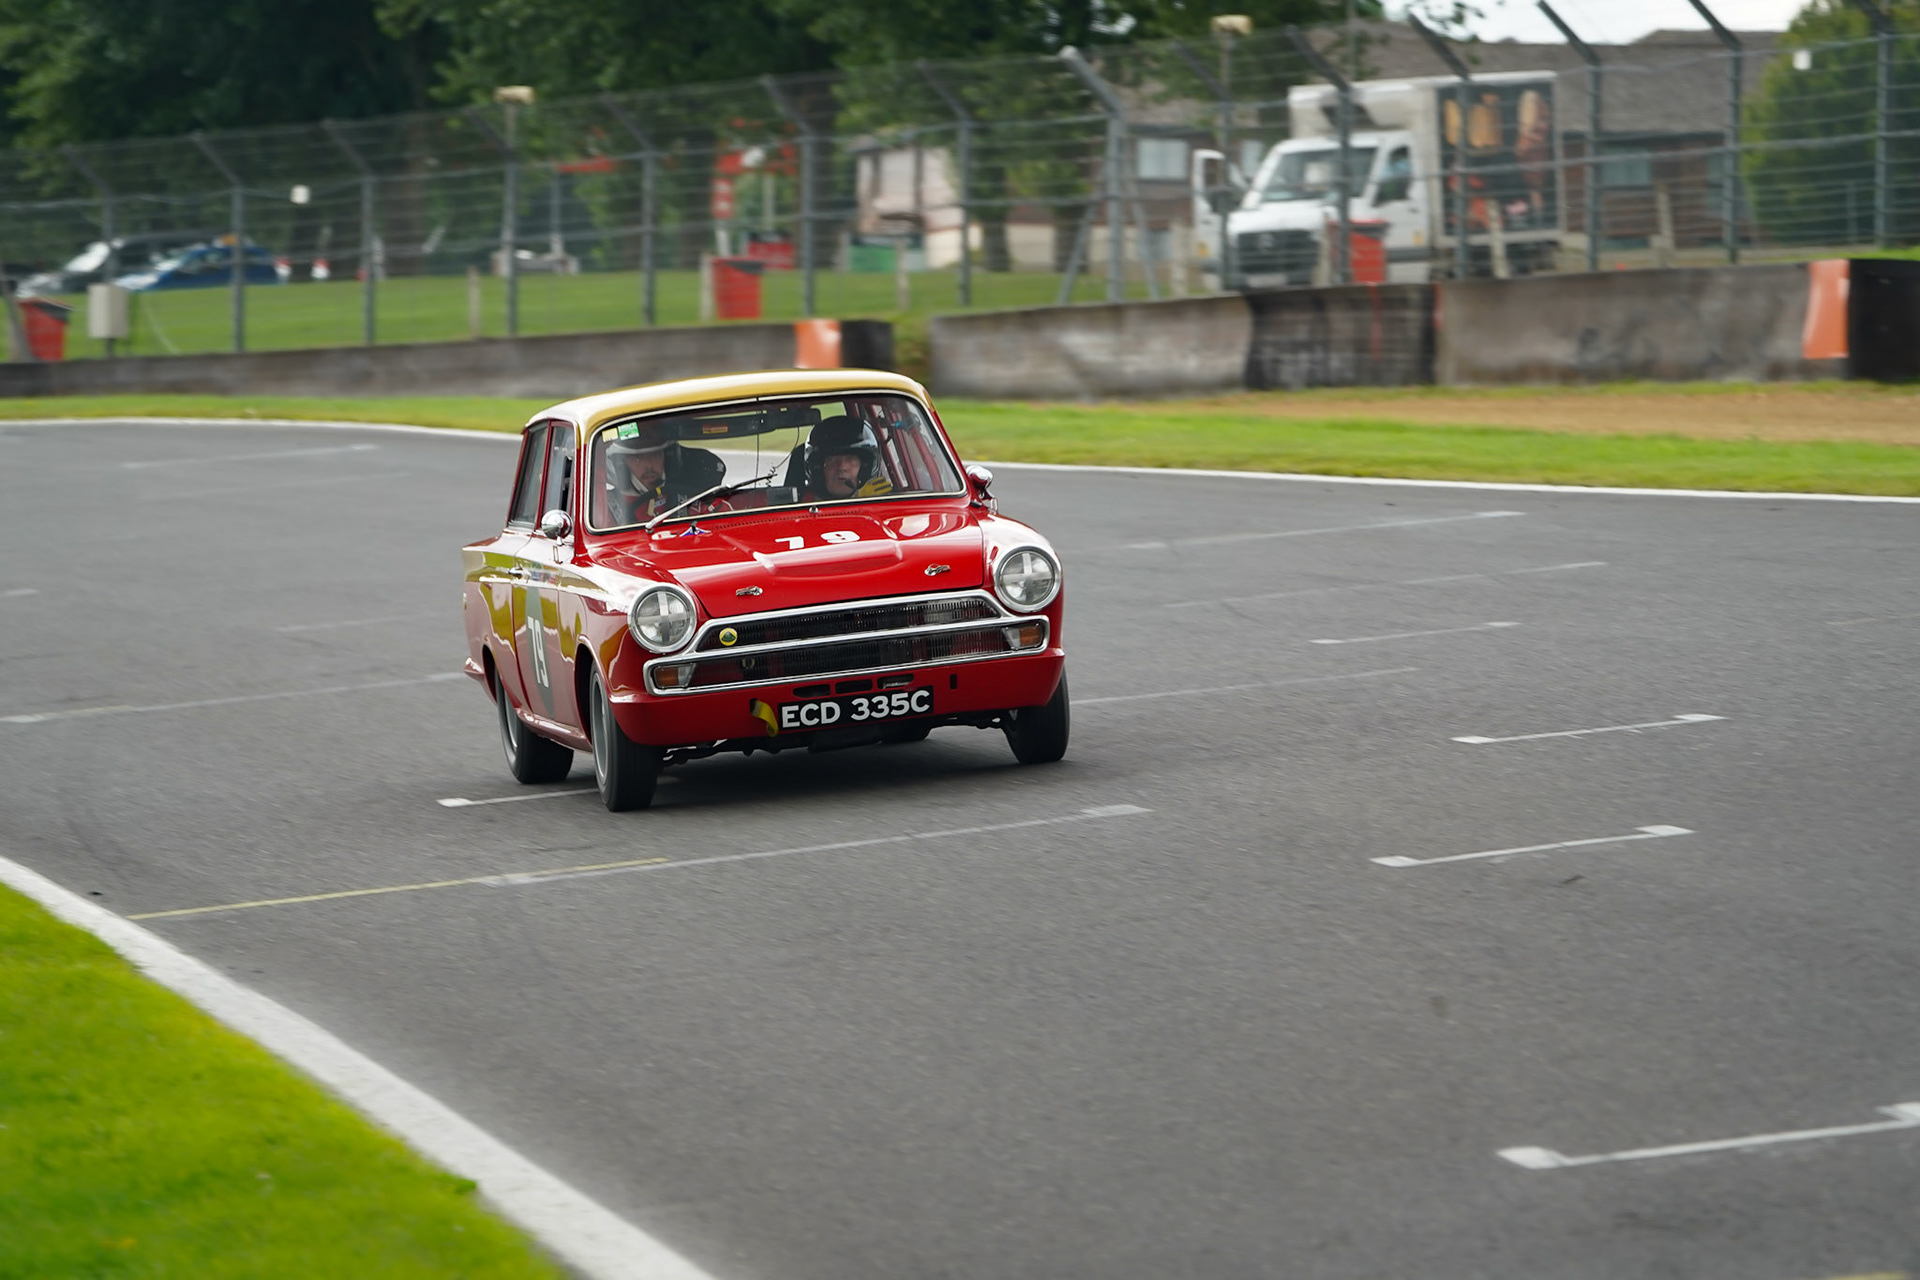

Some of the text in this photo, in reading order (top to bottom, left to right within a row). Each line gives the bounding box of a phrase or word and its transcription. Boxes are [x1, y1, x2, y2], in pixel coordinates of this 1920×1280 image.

[775, 531, 860, 549] 79
[527, 616, 549, 688] 79
[782, 690, 930, 728] ECD 335C
